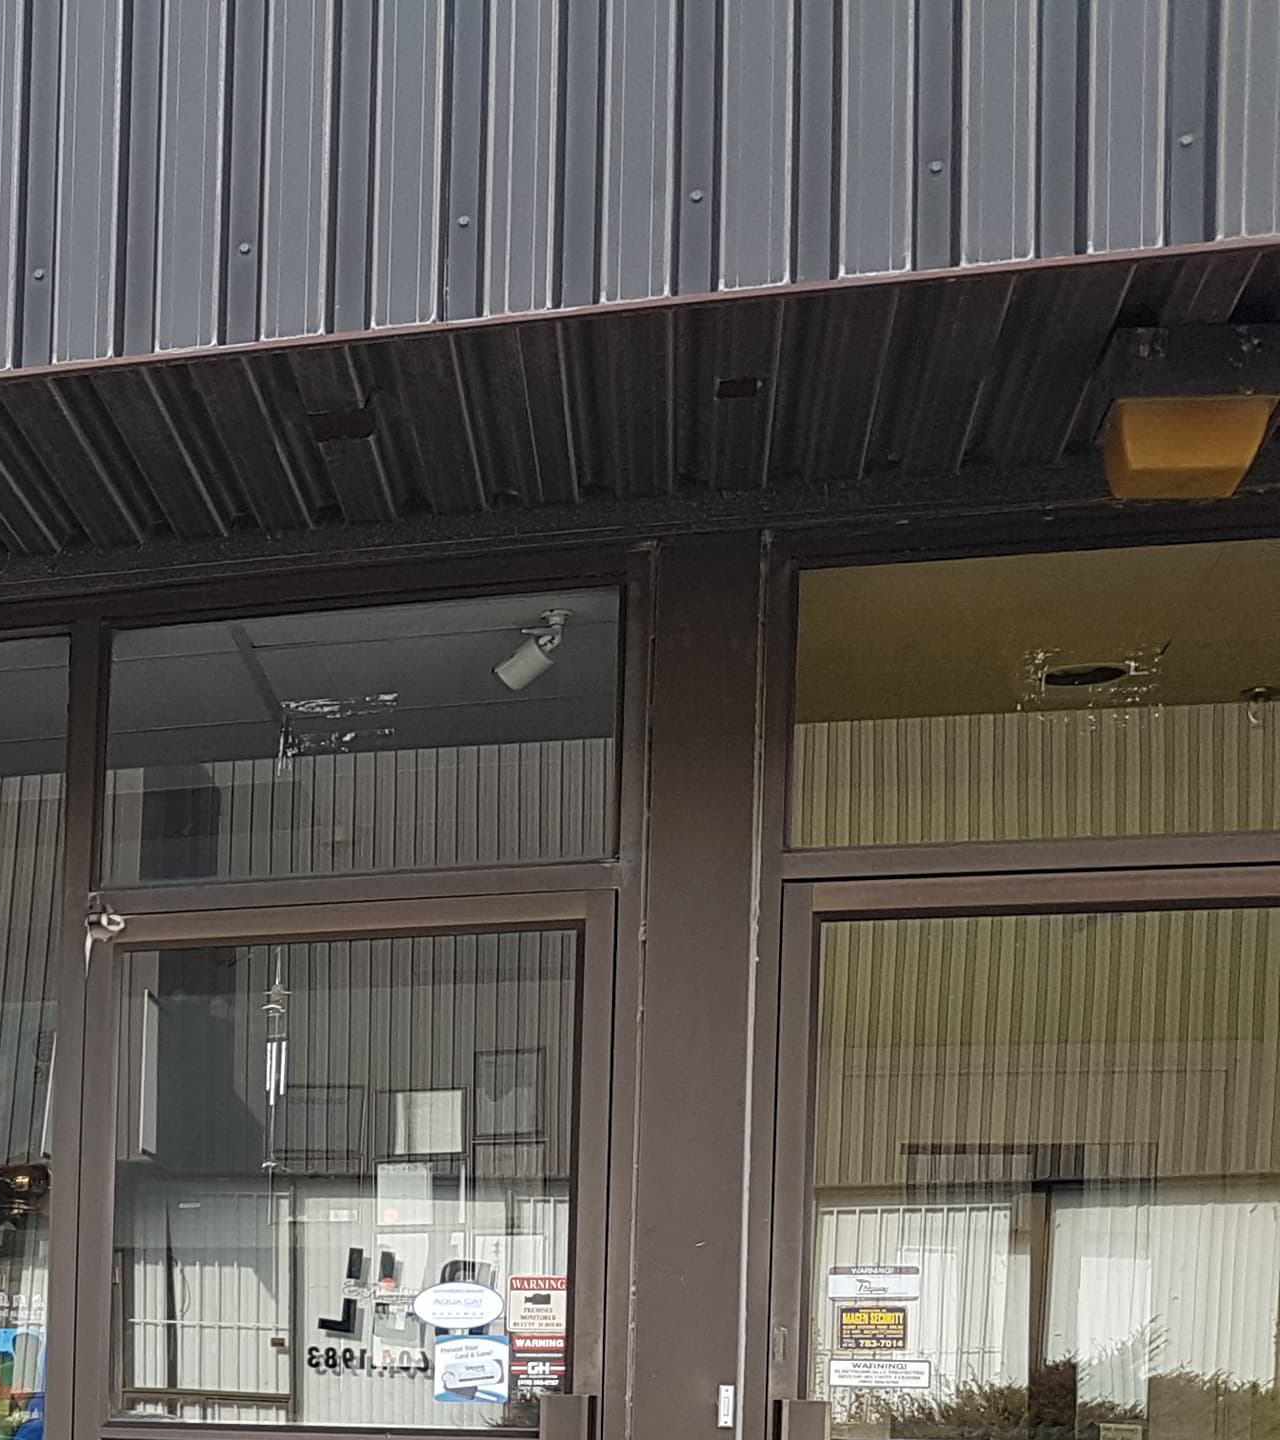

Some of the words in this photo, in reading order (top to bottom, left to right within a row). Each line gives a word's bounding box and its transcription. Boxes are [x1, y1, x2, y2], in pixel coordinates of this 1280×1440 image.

[512, 1278, 567, 1290] WARNING
[433, 1298, 462, 1306] AQUA
[514, 1339, 565, 1348] WARNING
